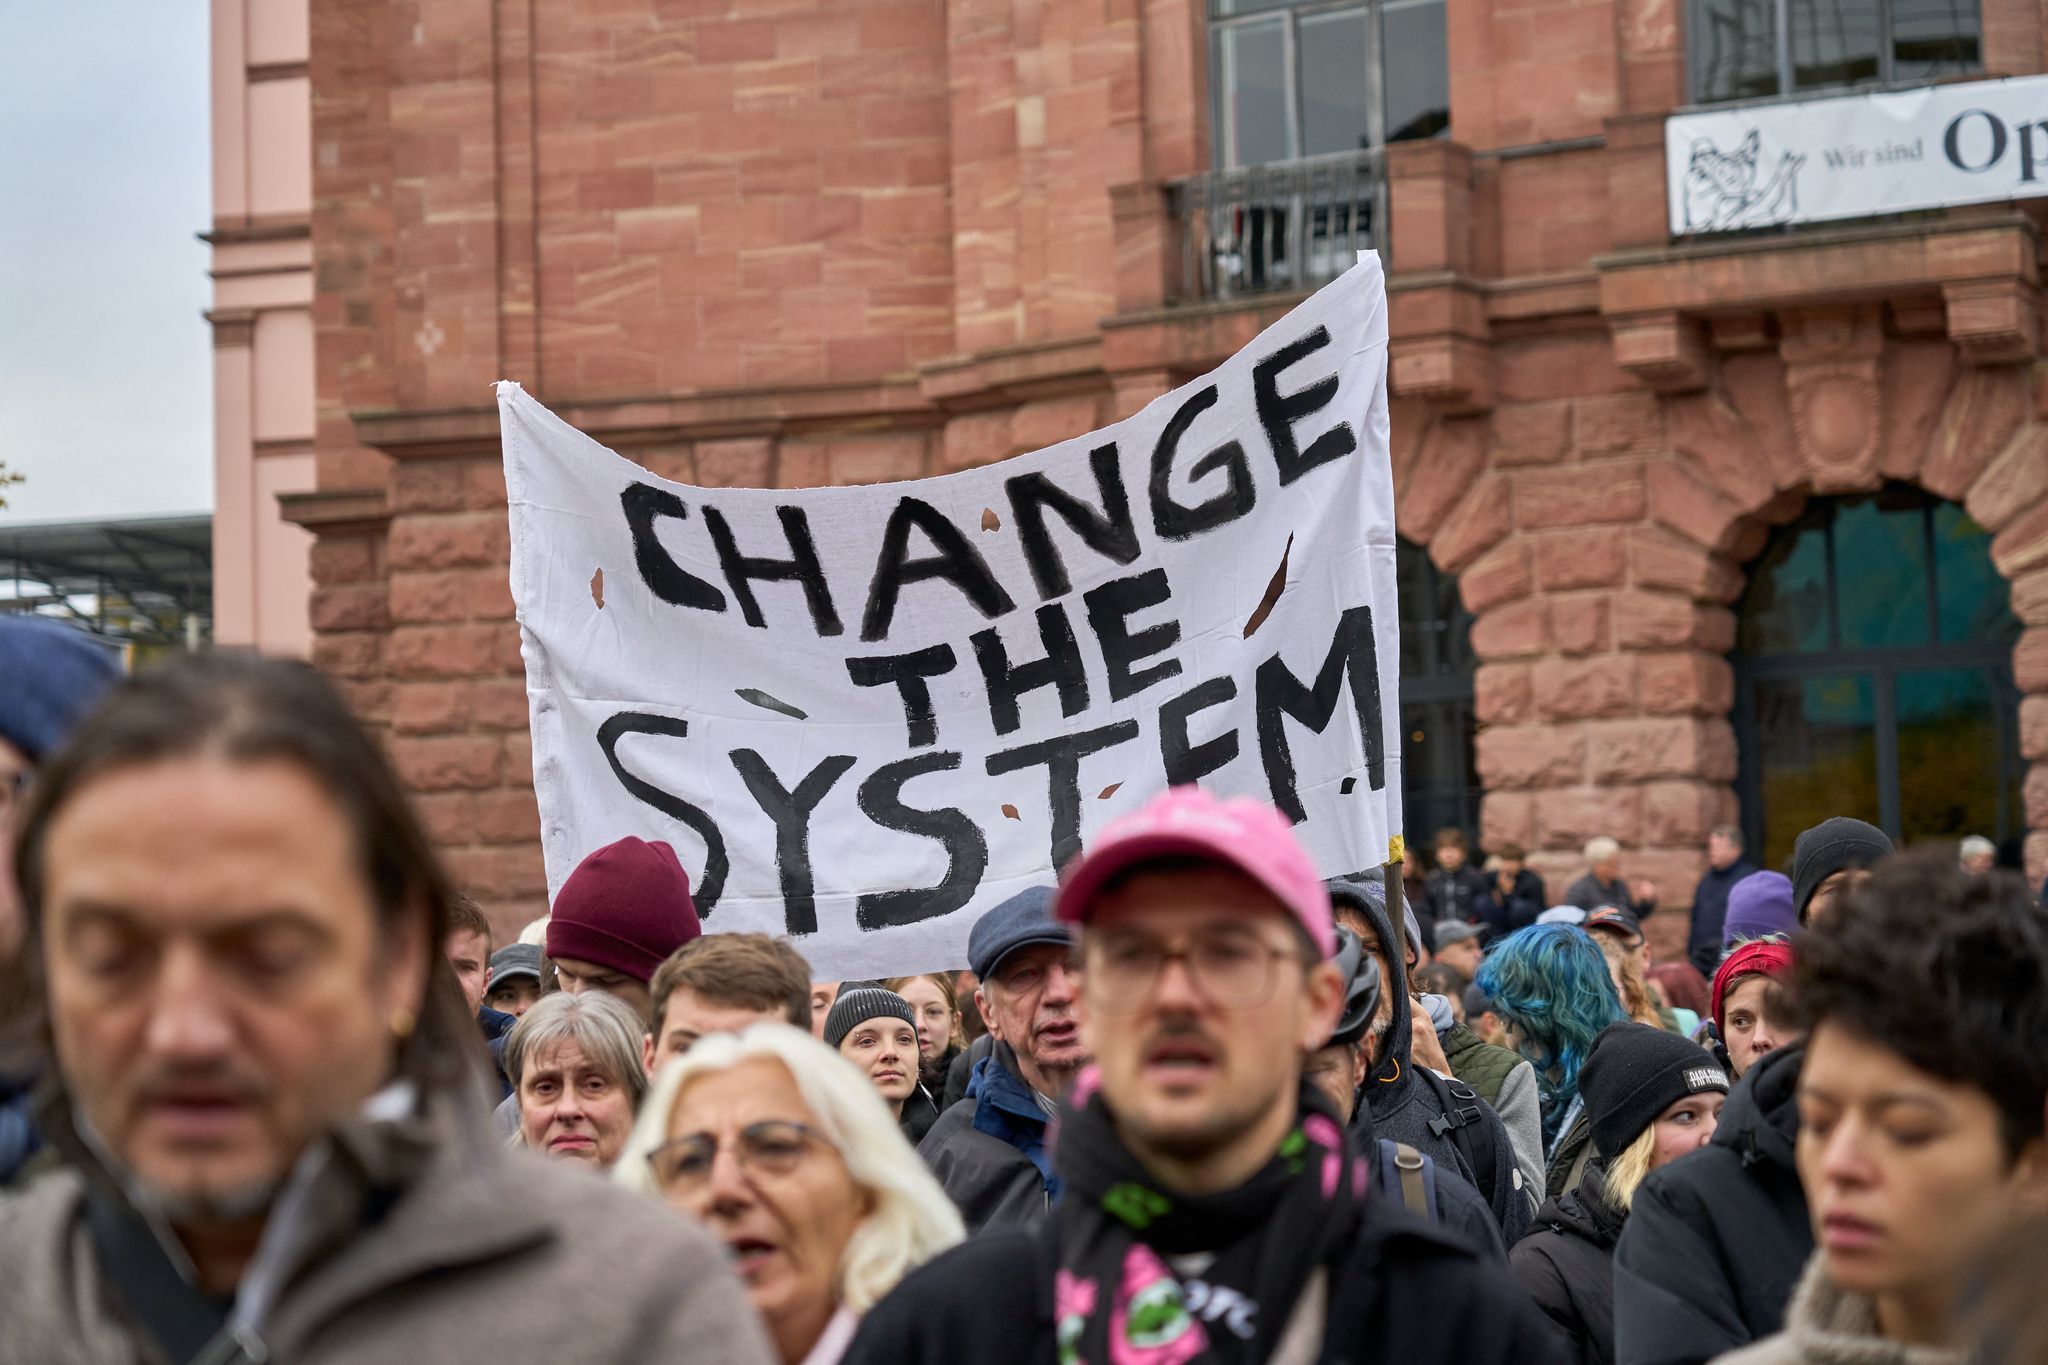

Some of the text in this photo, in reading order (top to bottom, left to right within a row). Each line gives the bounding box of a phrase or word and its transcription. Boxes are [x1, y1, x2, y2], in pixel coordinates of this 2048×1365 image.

[1822, 144, 1869, 170] Wir
[1873, 137, 1924, 167] sind
[620, 325, 1356, 643] CHANGE
[596, 606, 1385, 936] SYSTEM
[845, 568, 1182, 749] THE
